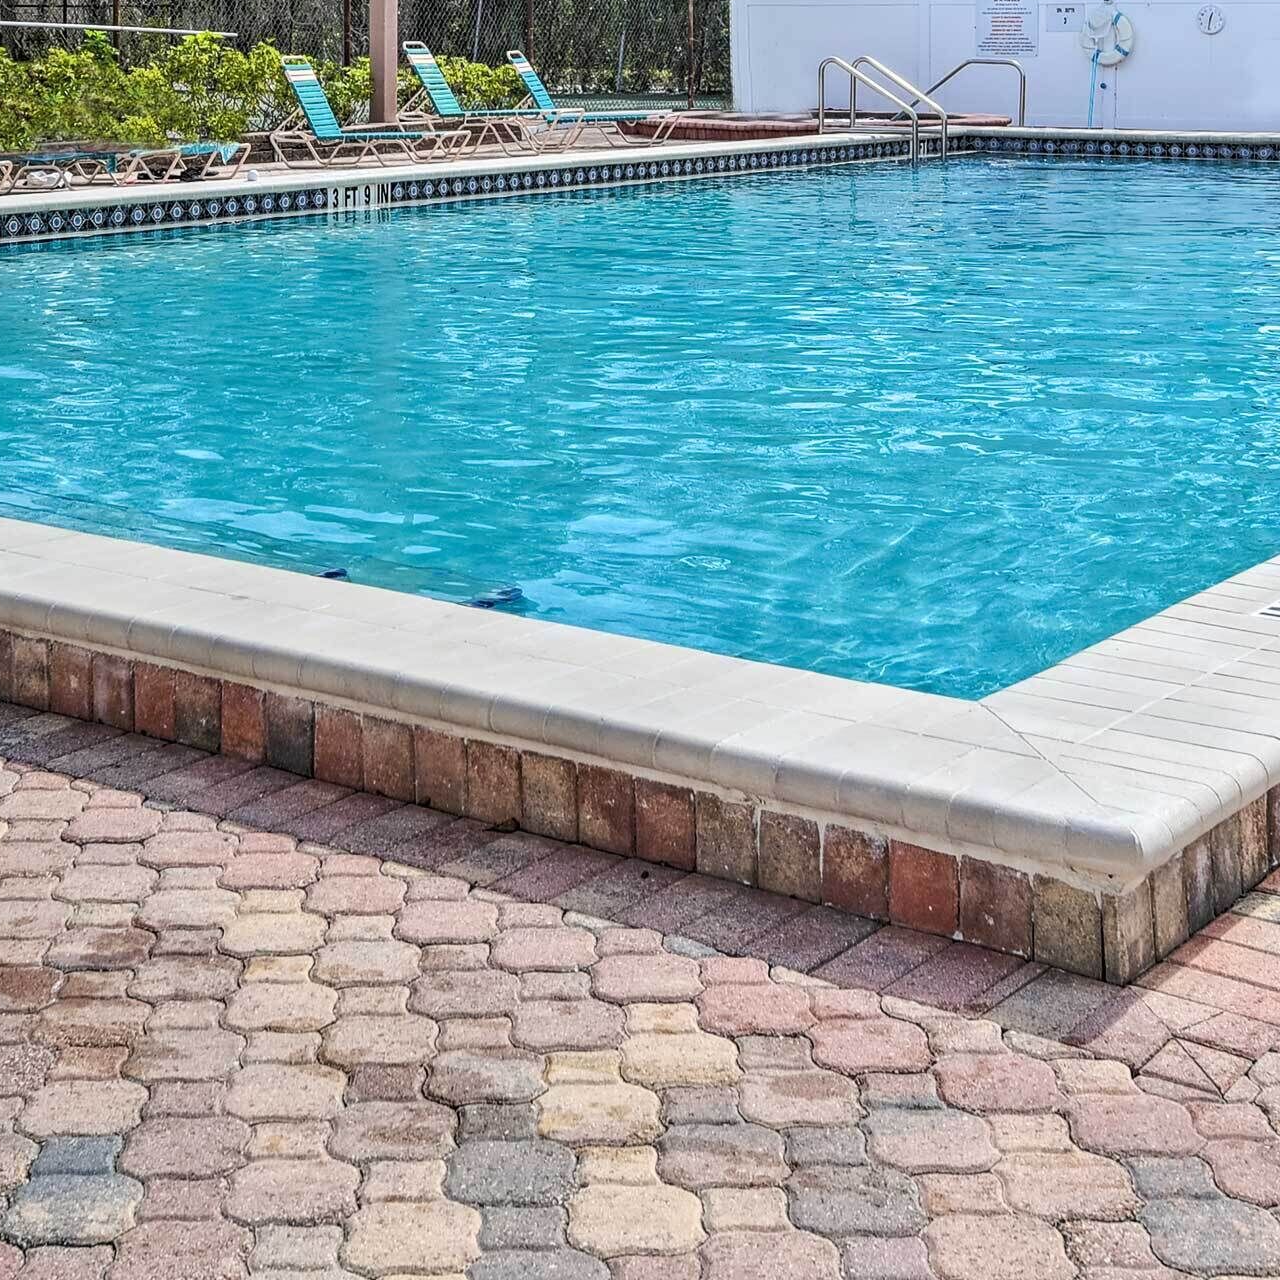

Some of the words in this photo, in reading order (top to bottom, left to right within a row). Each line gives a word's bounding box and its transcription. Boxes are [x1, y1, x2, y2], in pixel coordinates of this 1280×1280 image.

[332, 188, 339, 208] 3
[344, 186, 358, 208] FT
[364, 185, 371, 204] 9
[377, 183, 389, 203] IN
